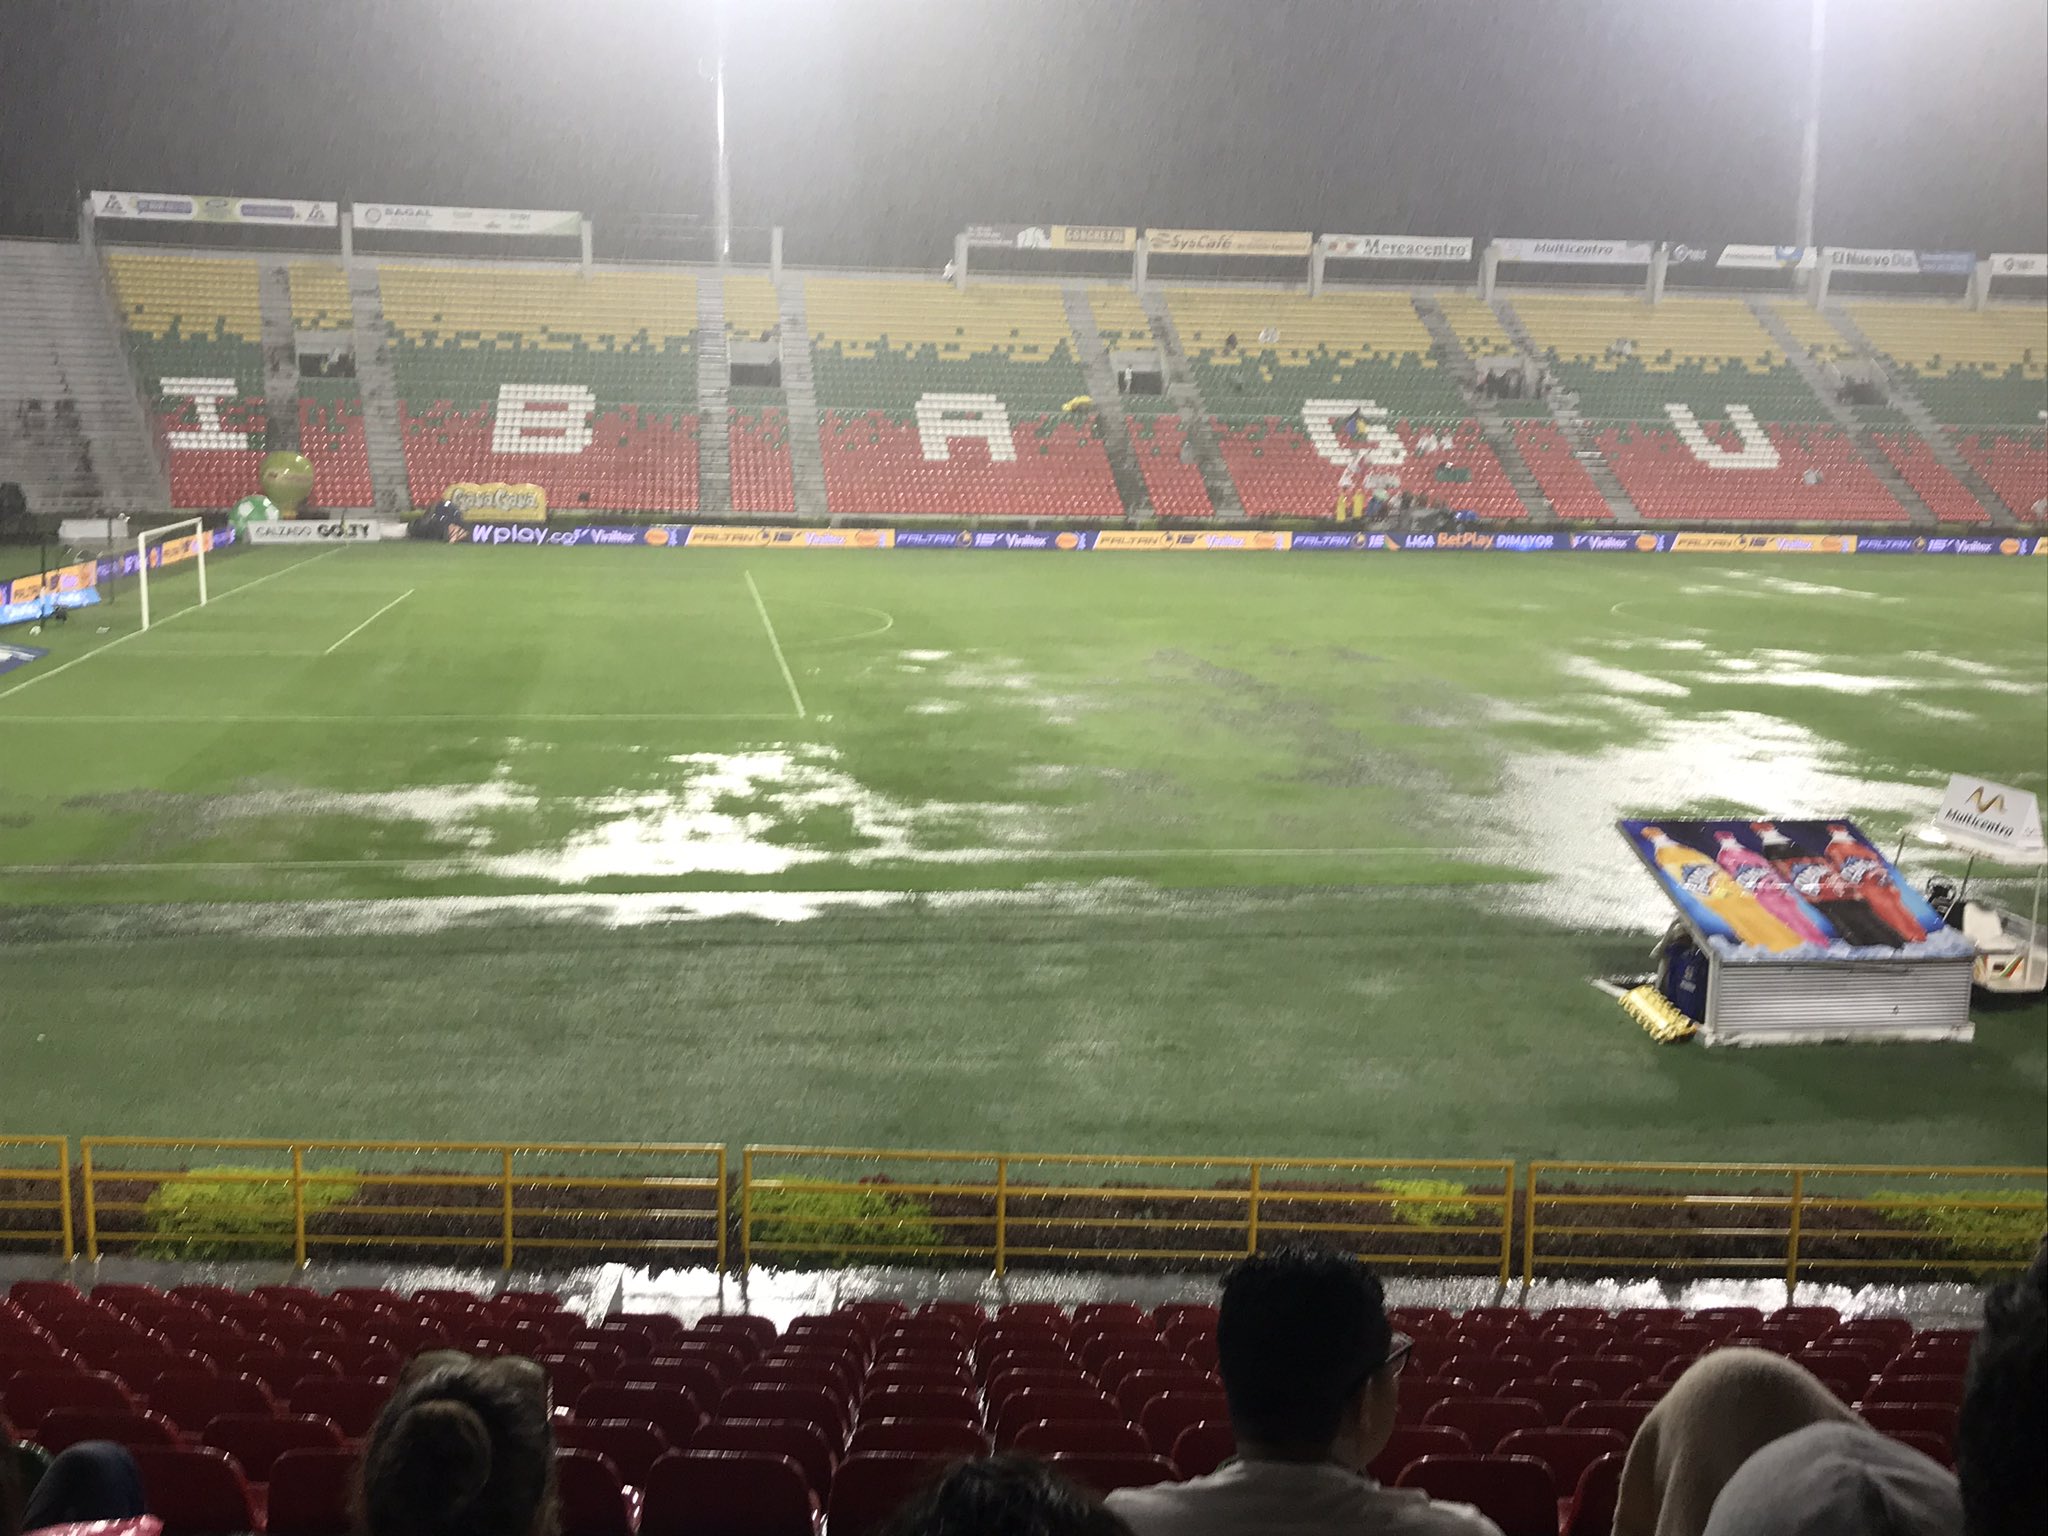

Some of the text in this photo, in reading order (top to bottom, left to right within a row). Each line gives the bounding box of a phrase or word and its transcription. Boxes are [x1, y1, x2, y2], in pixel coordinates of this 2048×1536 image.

[1363, 238, 1465, 256] Mercacentro
[1534, 242, 1614, 257] Multicentro
[897, 532, 957, 545] FALTAN
[1100, 535, 1159, 546] FALTAN
[1293, 535, 1350, 547] FALTAN
[1405, 532, 1554, 550] LIGA BetPlay DIMAYOR
[1858, 538, 1912, 550] FALTAN
[1944, 807, 2015, 838] Multicentro
